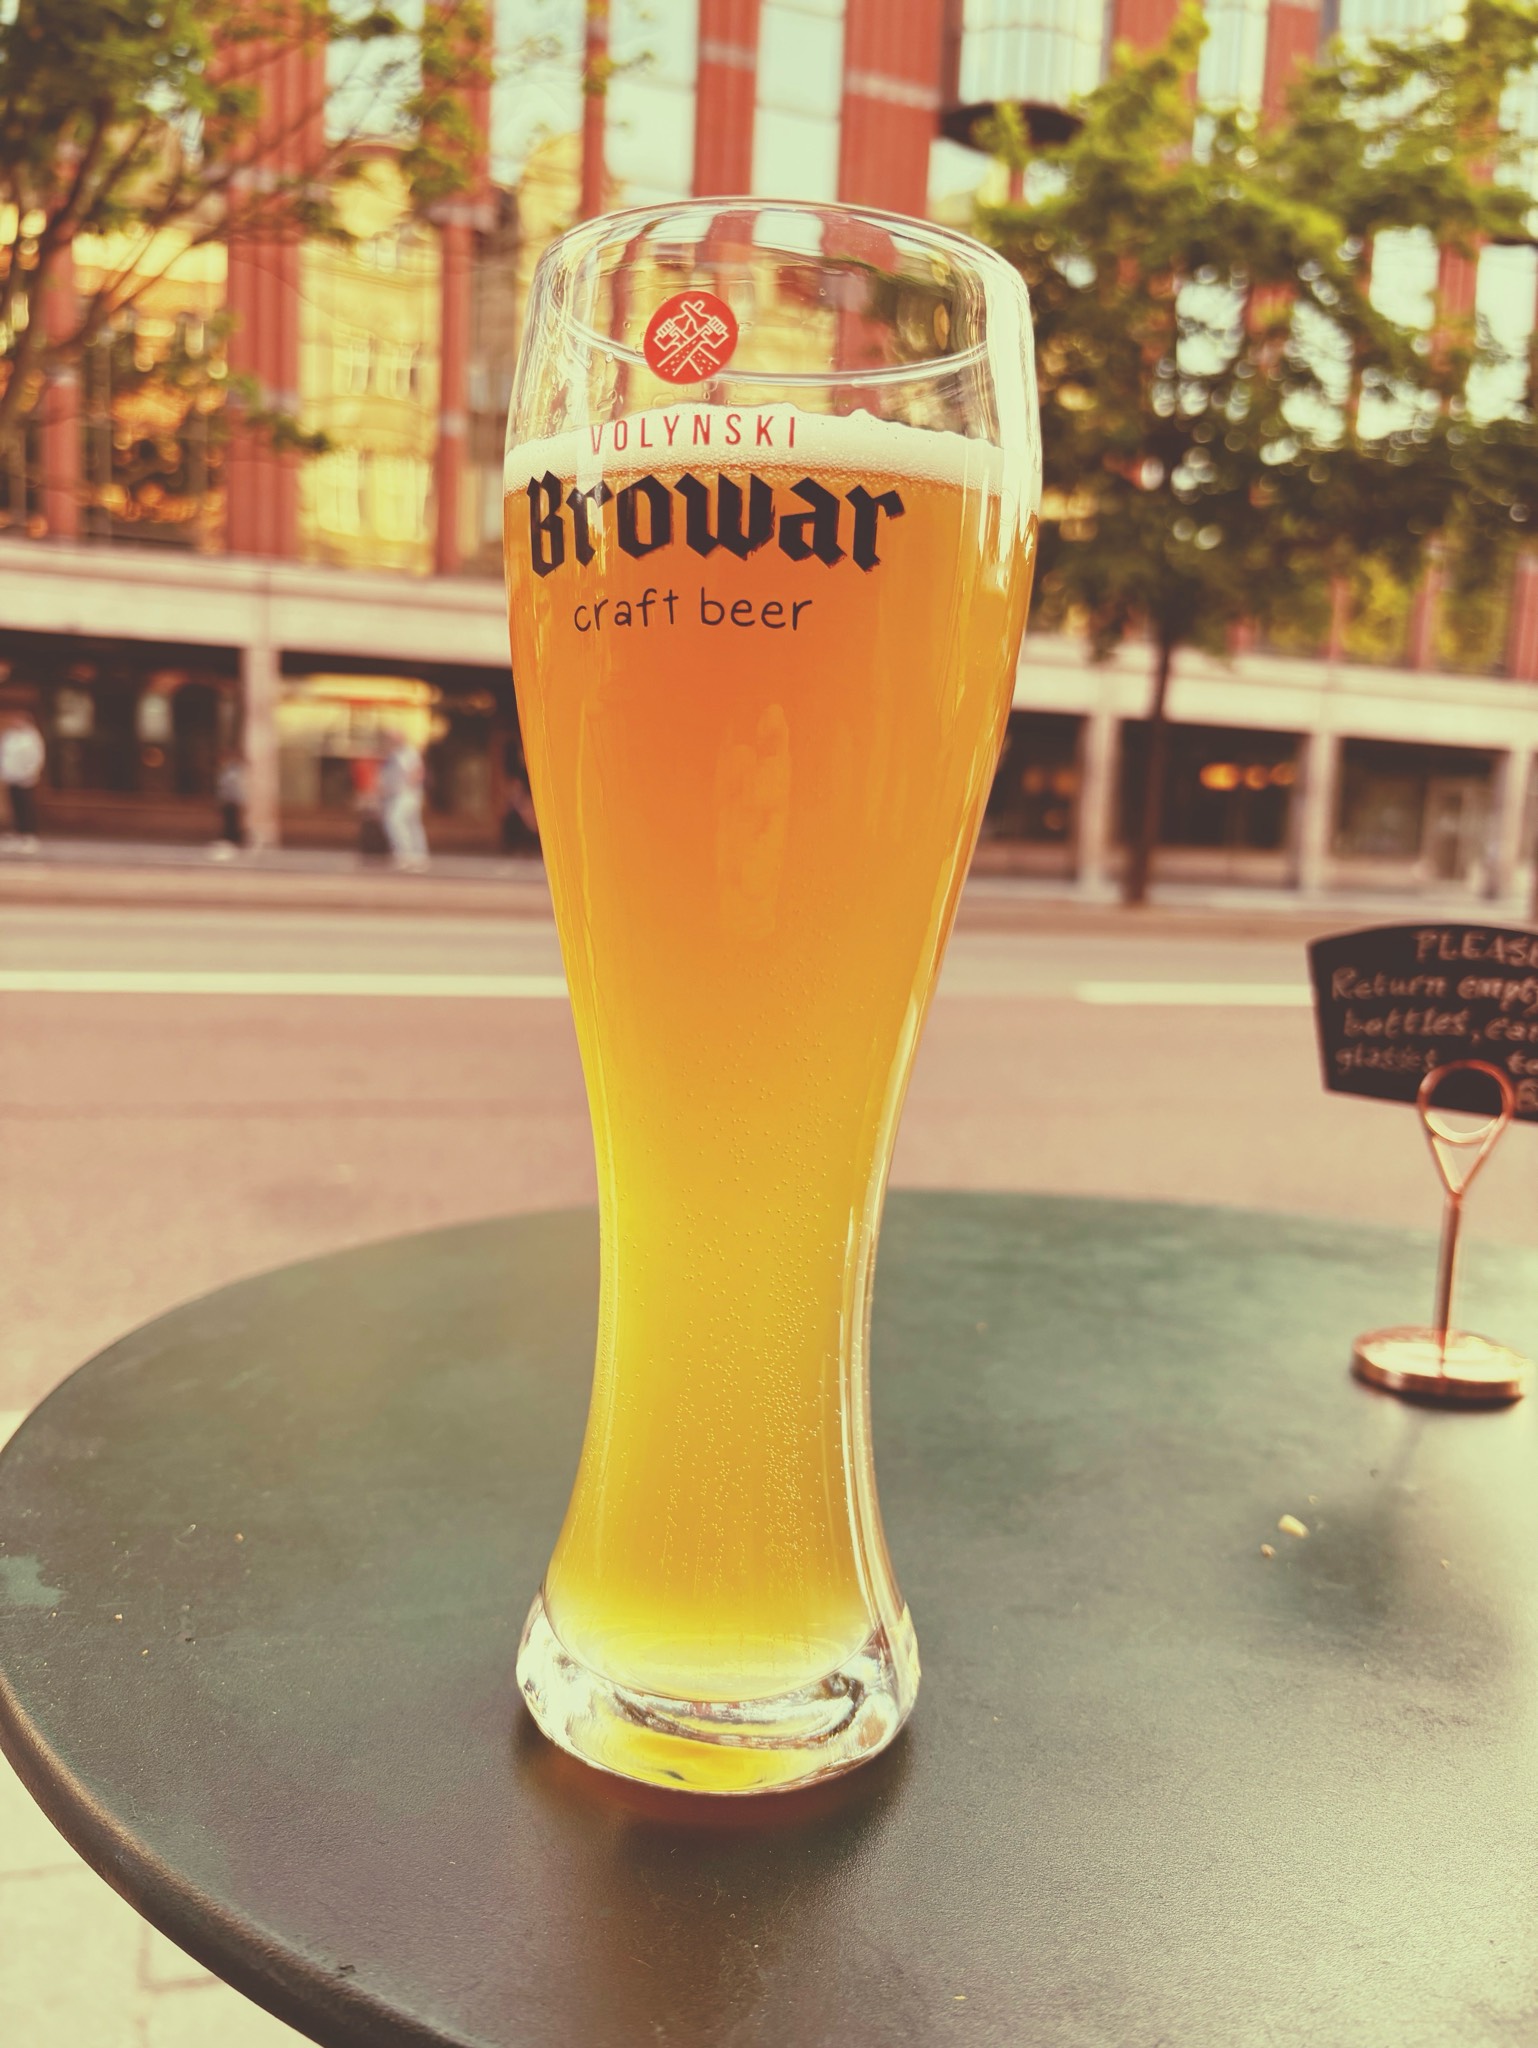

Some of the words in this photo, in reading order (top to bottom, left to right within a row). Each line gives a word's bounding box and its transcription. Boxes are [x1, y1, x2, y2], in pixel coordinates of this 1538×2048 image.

[590, 412, 797, 456] VOLYNSKI
[526, 469, 906, 579] Browar
[573, 587, 680, 633] craft
[700, 586, 813, 631] beer
[1331, 966, 1447, 1001] Return
